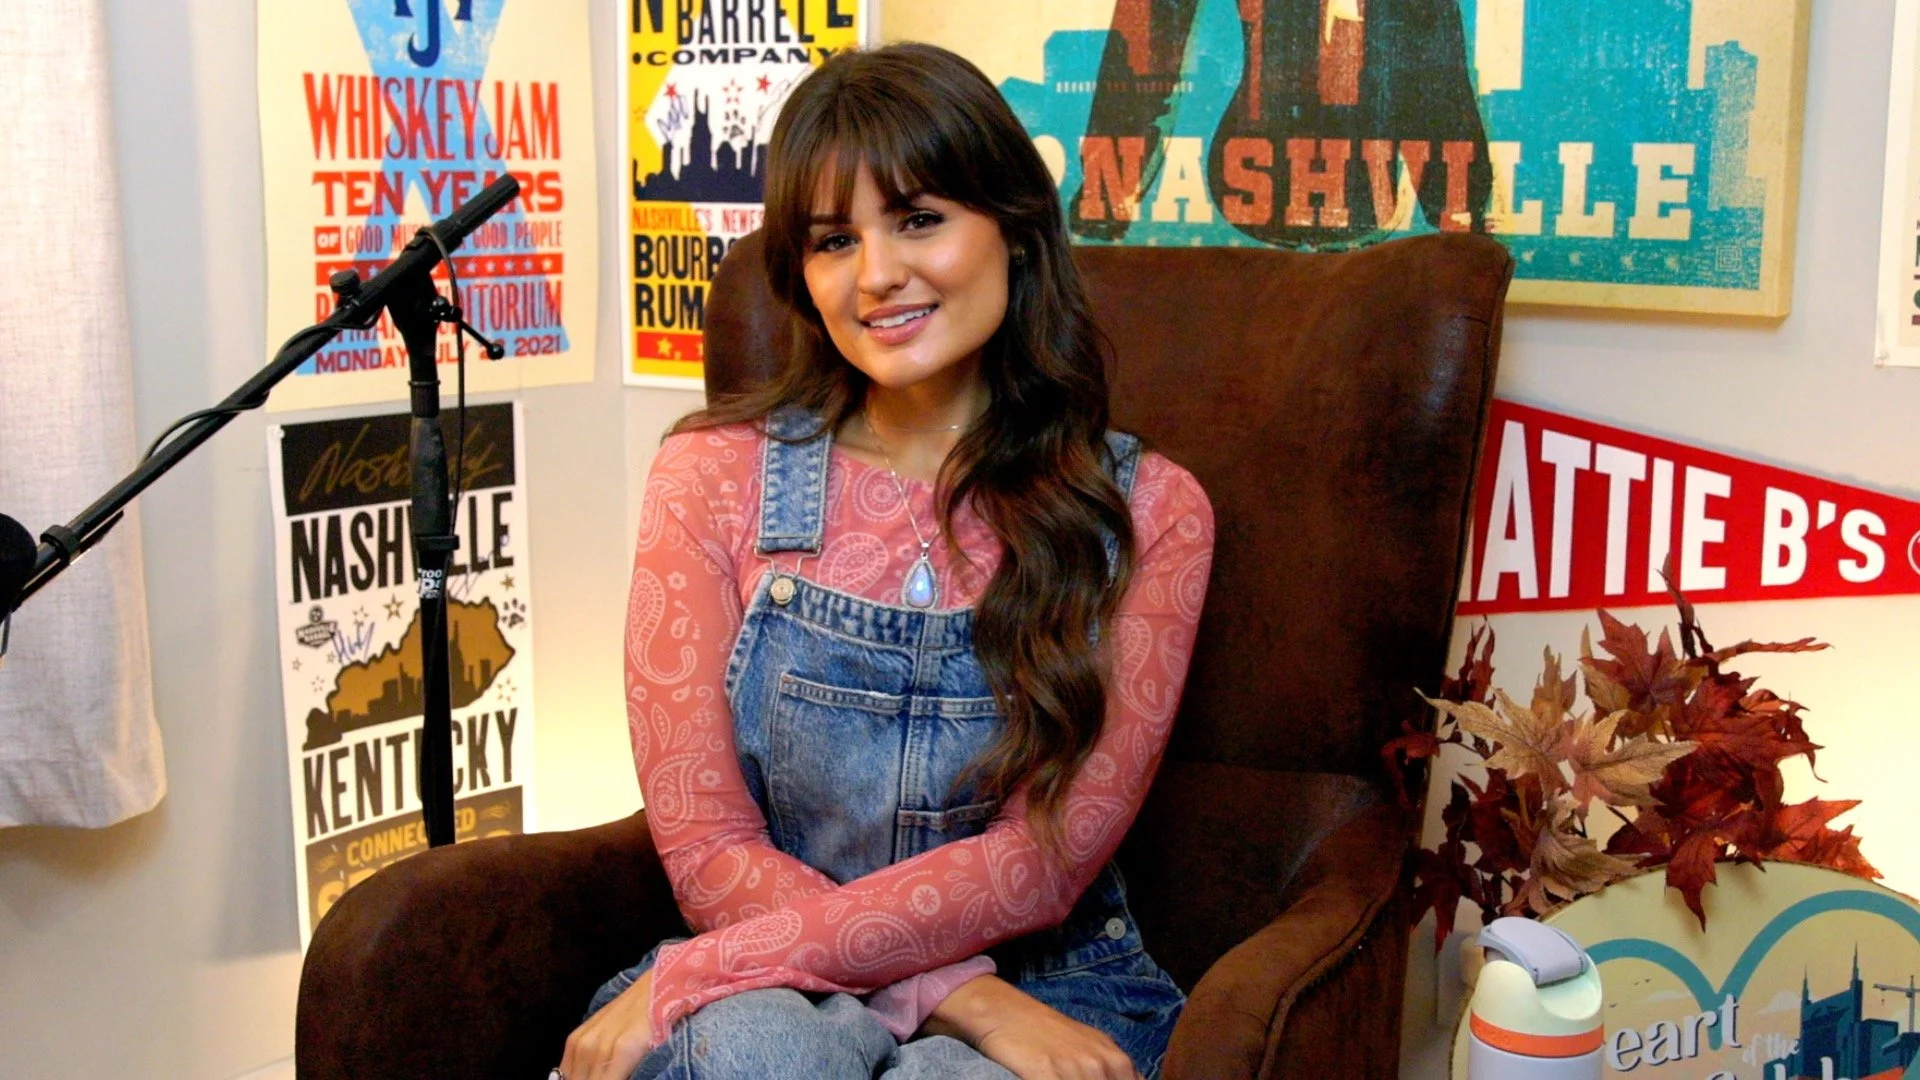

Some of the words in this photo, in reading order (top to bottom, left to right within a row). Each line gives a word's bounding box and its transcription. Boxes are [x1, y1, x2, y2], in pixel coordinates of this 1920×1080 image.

[647, 48, 838, 66] COMPANY
[303, 73, 483, 160] WHISKEY
[485, 80, 561, 160] JAM
[312, 171, 404, 216] TEN
[1078, 137, 1694, 240] NASHVILLE
[317, 232, 340, 248] OF
[346, 225, 383, 253] GOOD
[514, 220, 562, 248] PEOPLE
[634, 234, 736, 281] BOURB
[434, 280, 562, 336] UDITORIUM
[635, 283, 704, 330] RUM
[514, 335, 561, 357] 2021
[291, 491, 514, 603] NASHLE
[346, 806, 476, 868] CONNECD
[1604, 993, 1743, 1073] eart
